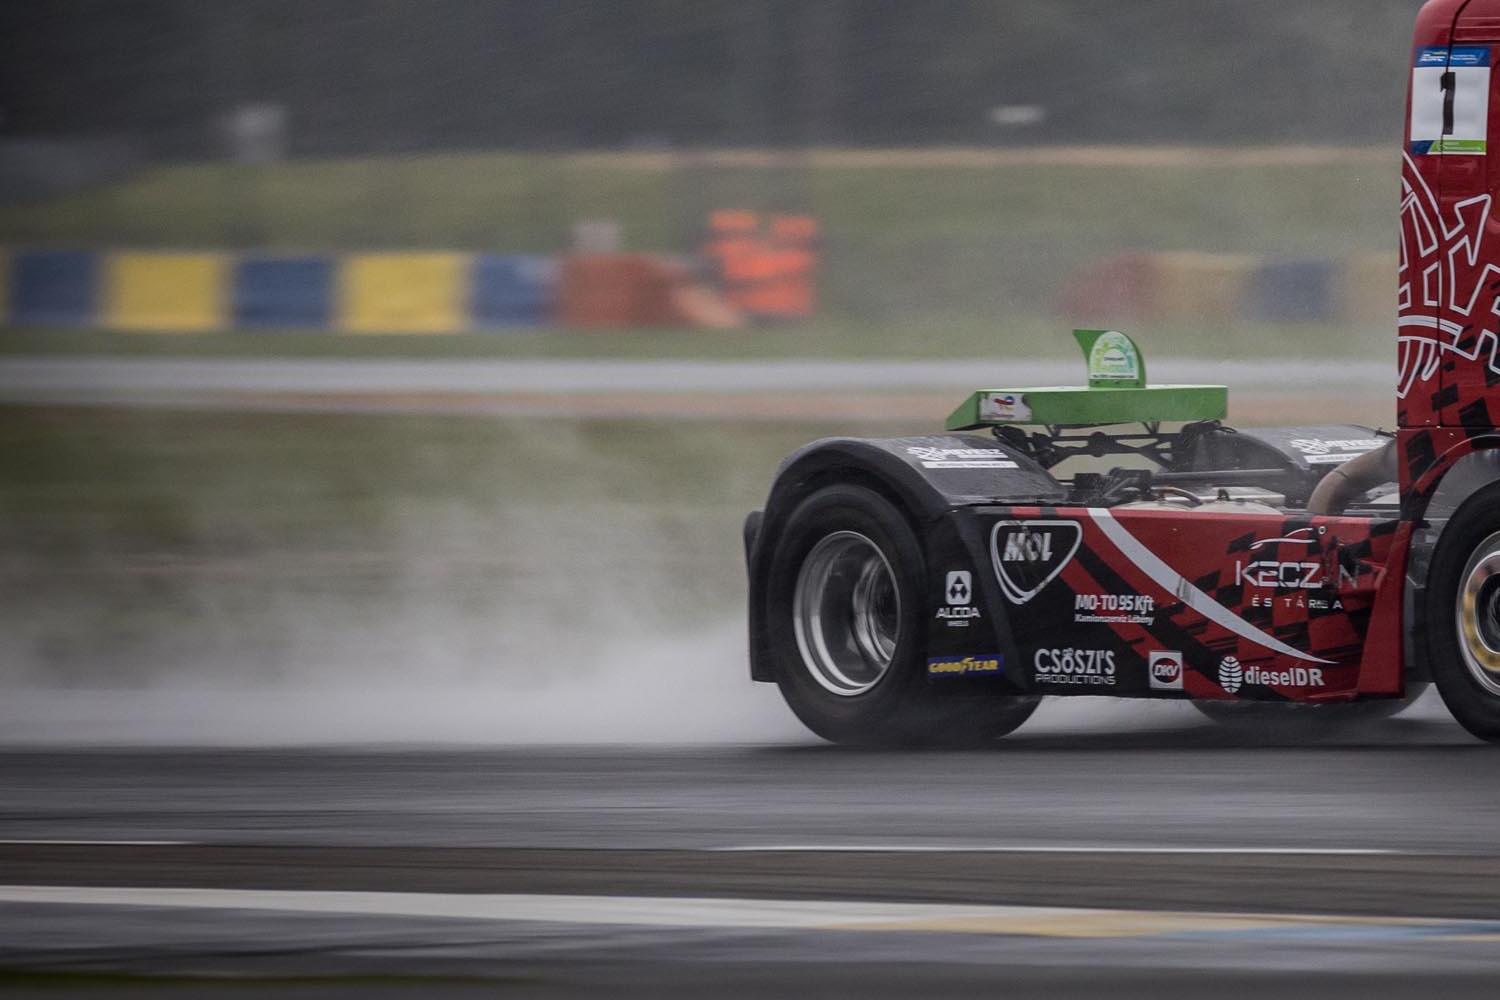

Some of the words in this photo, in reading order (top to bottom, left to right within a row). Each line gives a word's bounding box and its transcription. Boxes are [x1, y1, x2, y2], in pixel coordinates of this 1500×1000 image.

[1440, 72, 1456, 135] 1
[1118, 595, 1133, 611] 95
[1134, 595, 1154, 615] Kft
[928, 657, 998, 674] GOODYEAR
[1154, 664, 1178, 676] DKV
[1035, 673, 1116, 685] PRODUCTIONS
[1244, 666, 1326, 686] dieselDR
